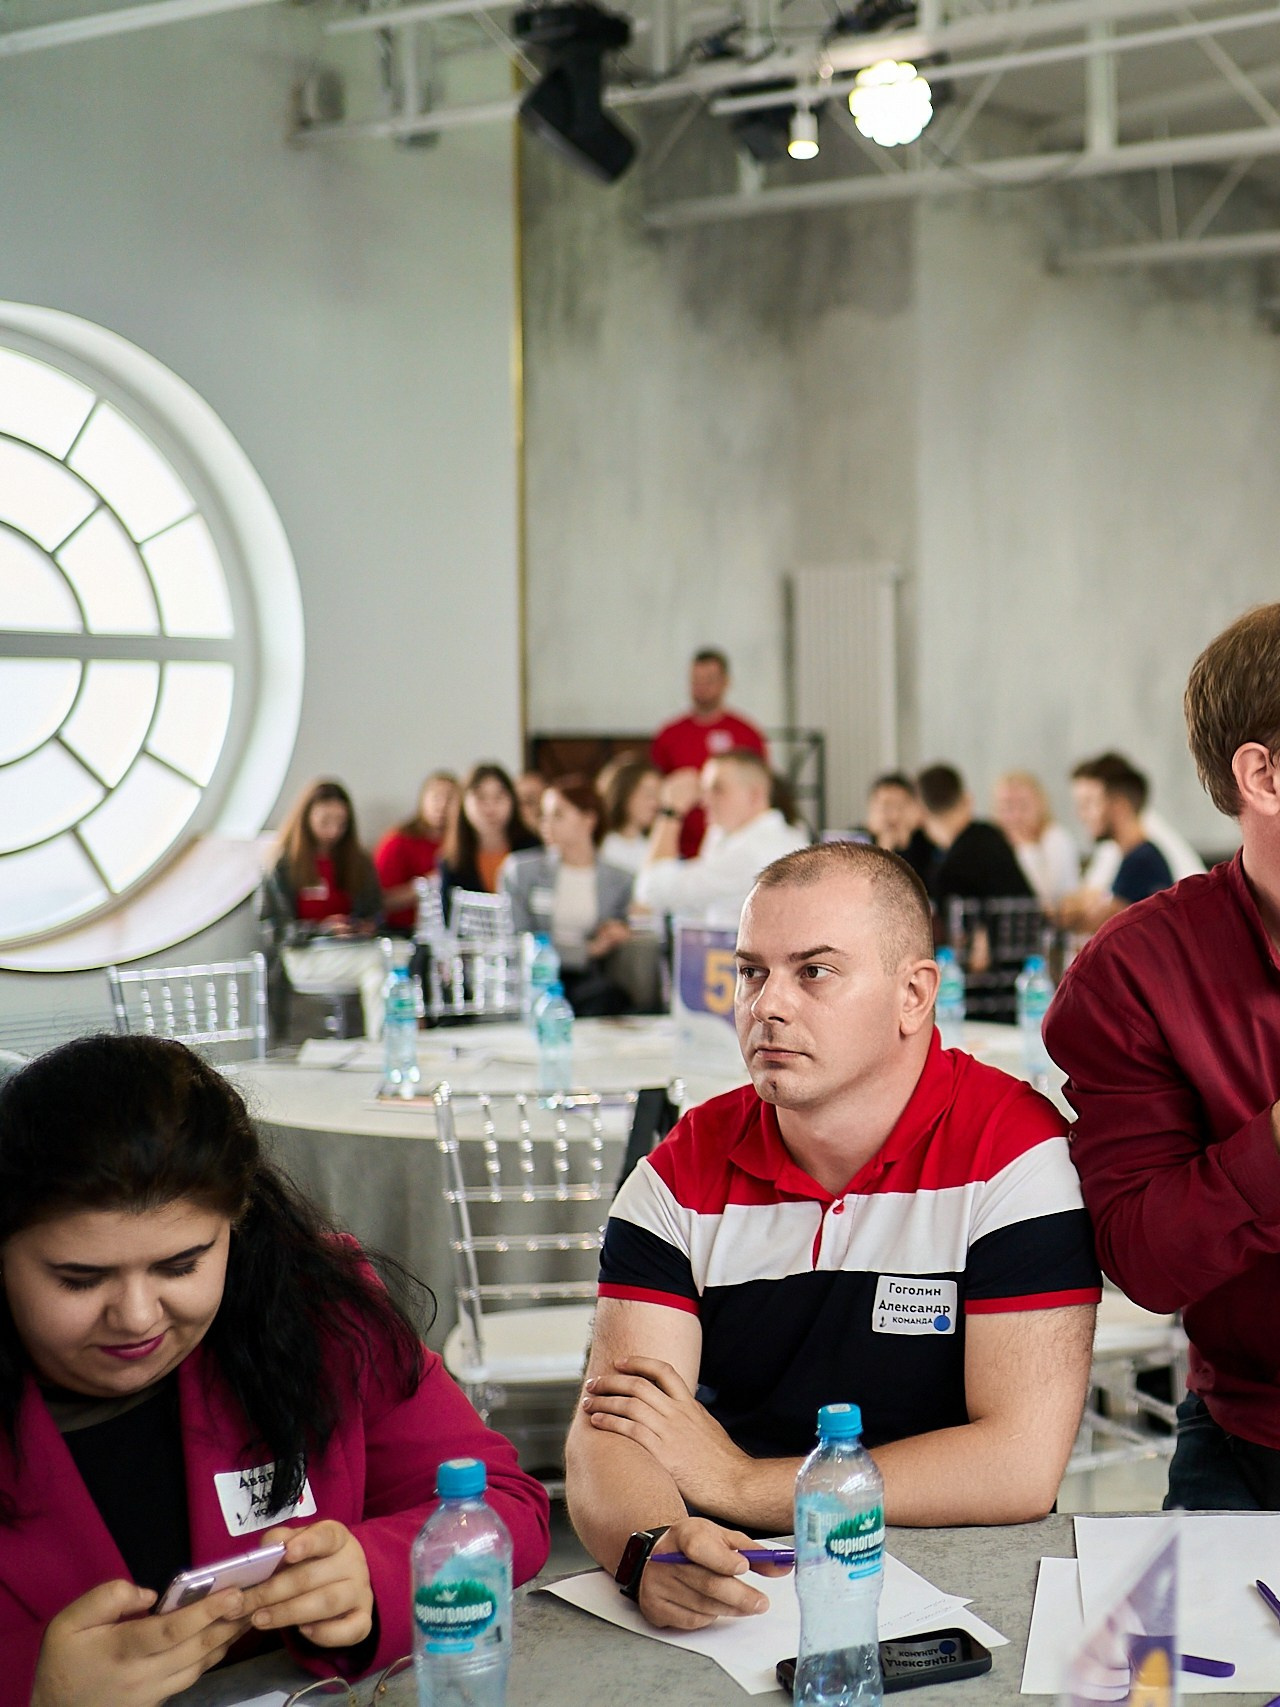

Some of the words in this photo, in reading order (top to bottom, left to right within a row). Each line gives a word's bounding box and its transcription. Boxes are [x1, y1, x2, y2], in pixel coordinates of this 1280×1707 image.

[705, 948, 737, 1015] 5
[889, 1282, 941, 1296] Гоголин
[879, 1299, 951, 1316] Александр
